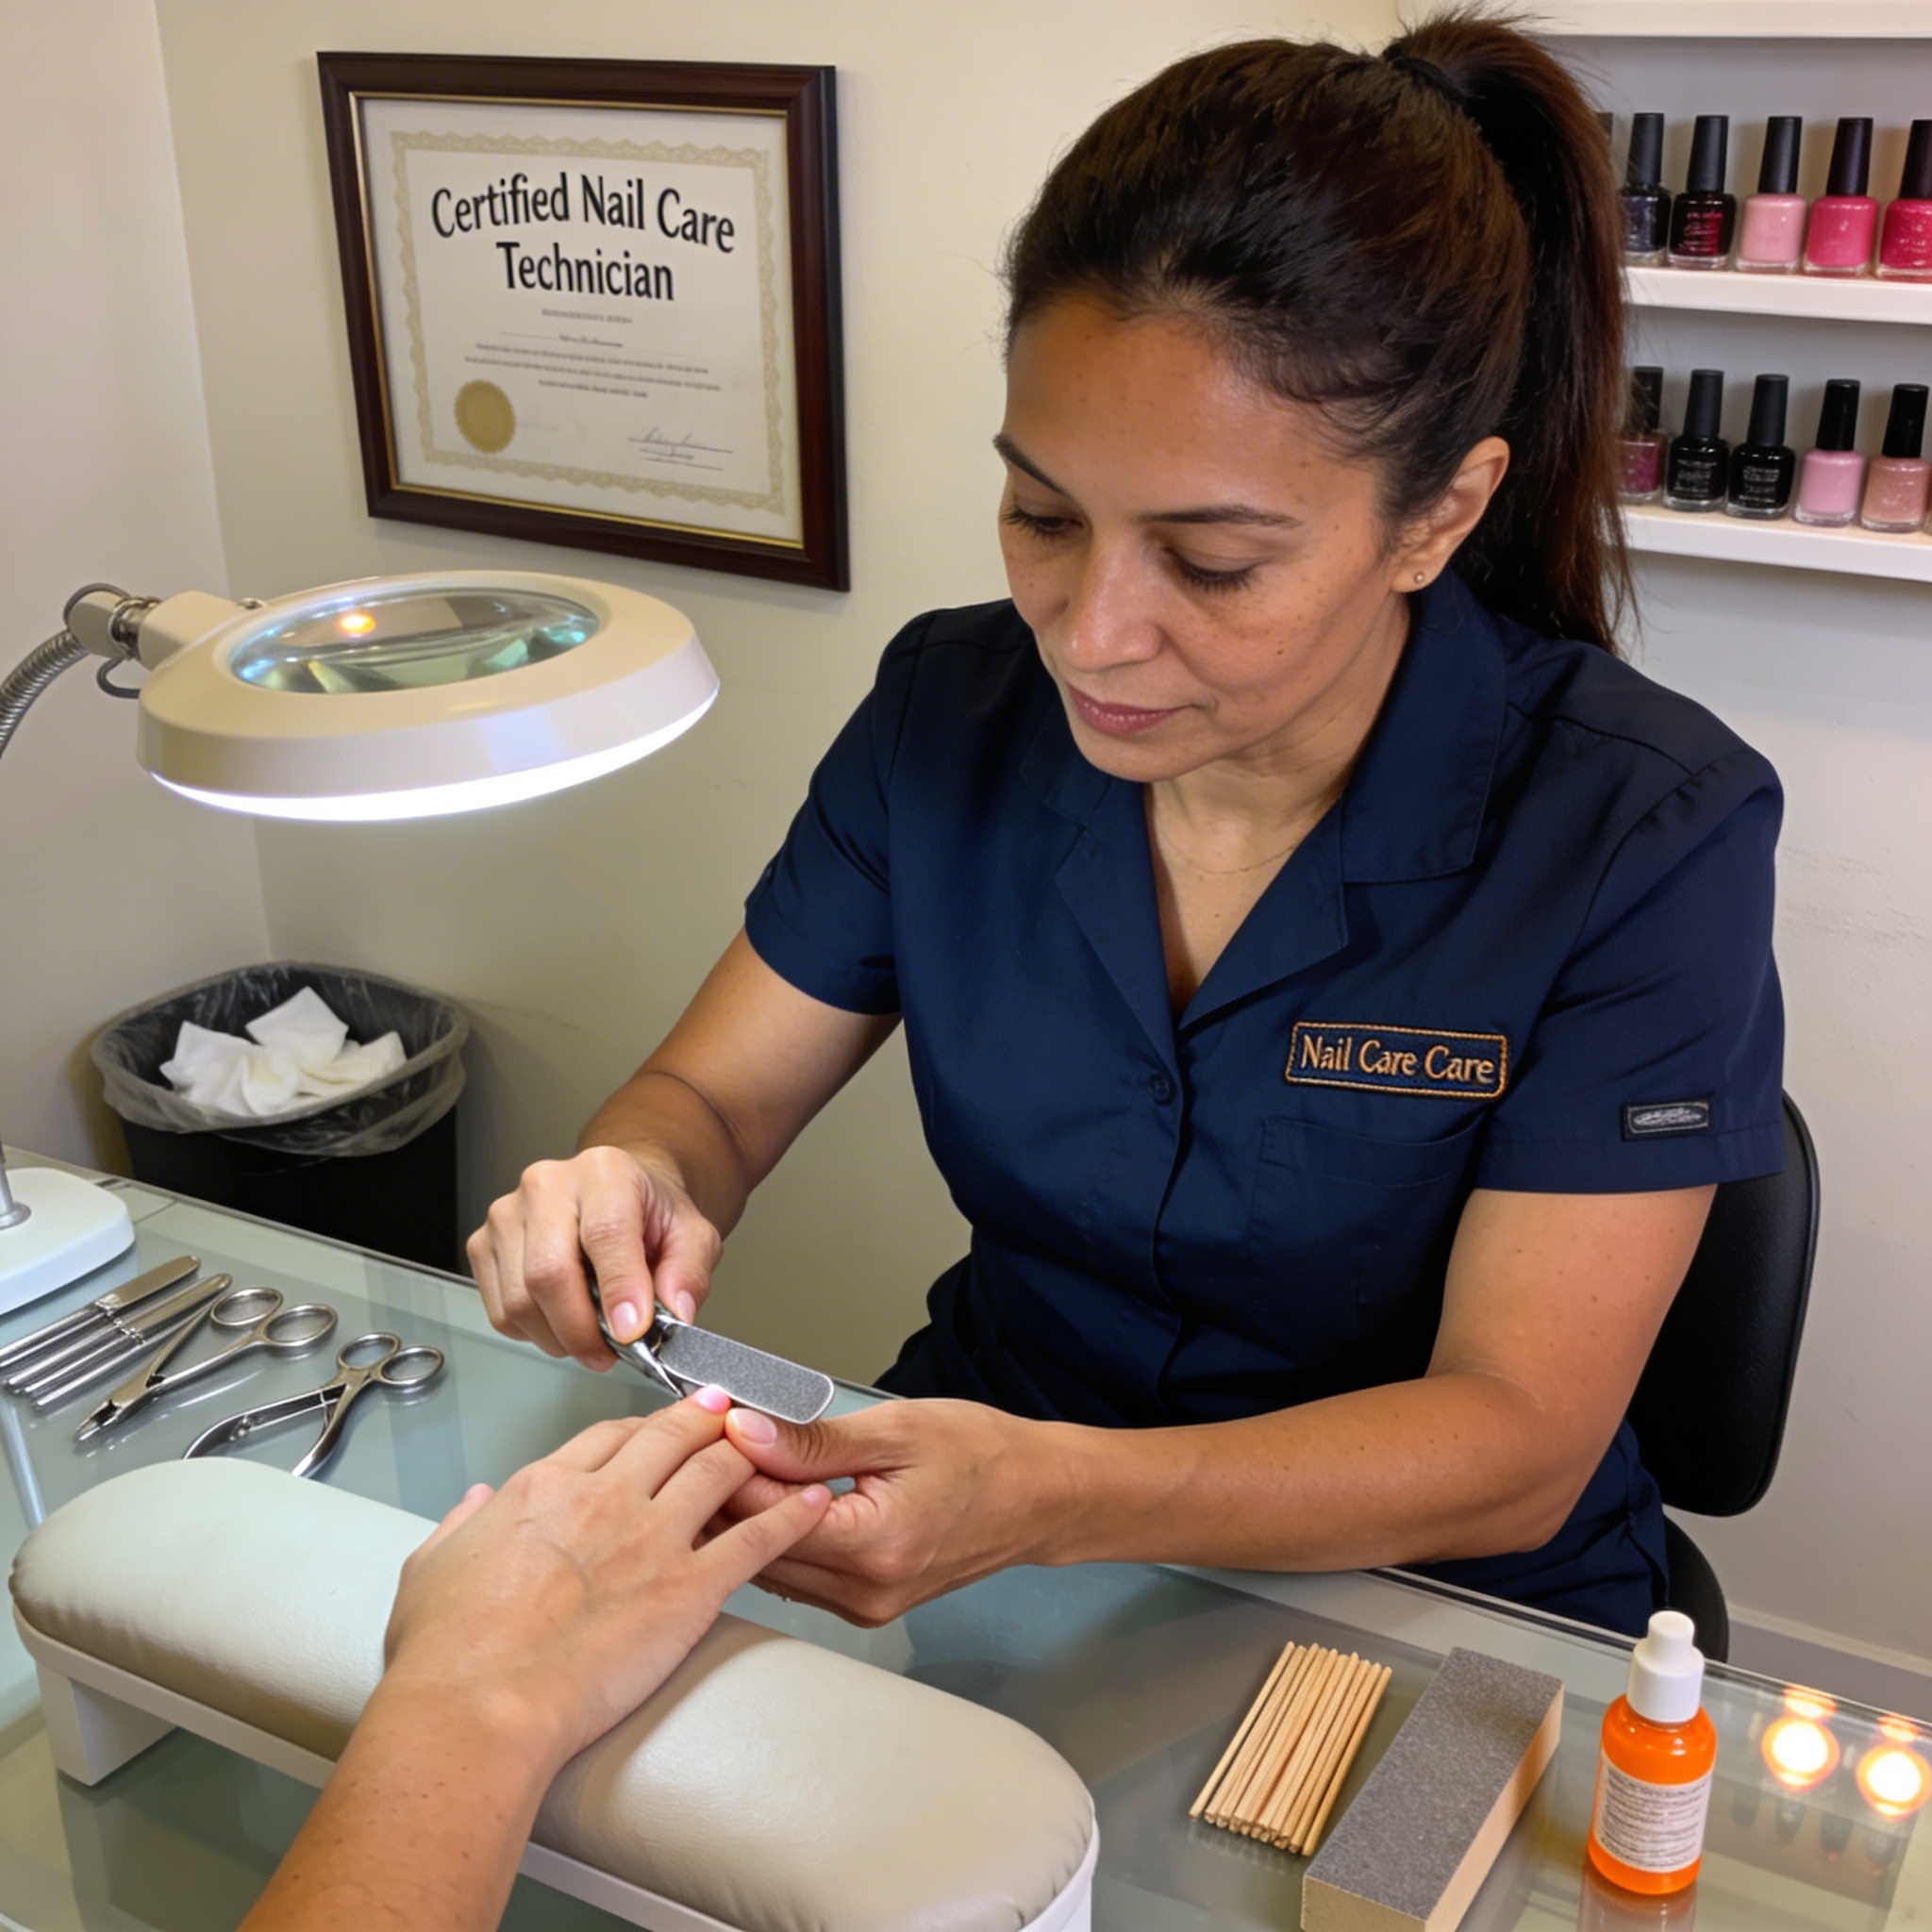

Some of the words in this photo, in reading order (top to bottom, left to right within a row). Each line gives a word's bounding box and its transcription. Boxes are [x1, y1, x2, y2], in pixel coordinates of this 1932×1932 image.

[431, 172, 570, 239] Certified
[581, 174, 645, 230] Nail
[657, 188, 735, 253] Care
[496, 242, 675, 301] Technician
[1300, 1035, 1351, 1073] Nail
[1358, 1040, 1418, 1077] Care
[1424, 1044, 1495, 1084] Care
